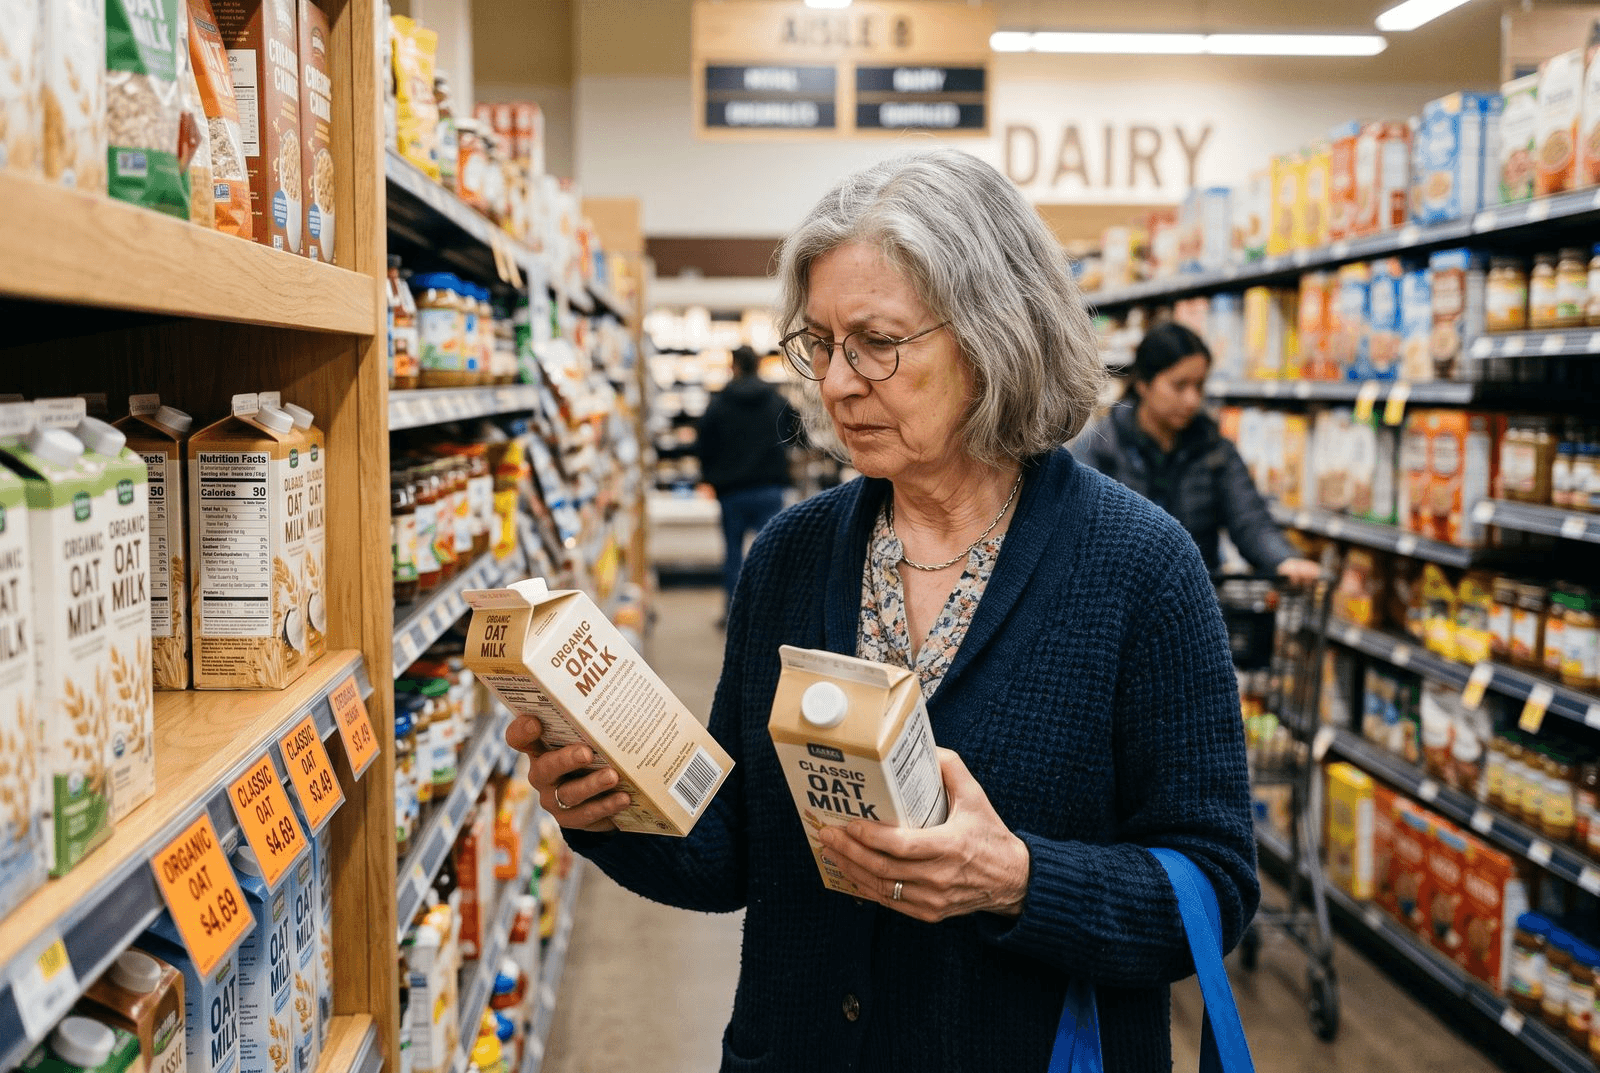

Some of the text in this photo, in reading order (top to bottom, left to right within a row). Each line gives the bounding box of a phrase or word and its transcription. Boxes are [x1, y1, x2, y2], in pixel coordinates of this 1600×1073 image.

[1004, 124, 1214, 188] DAIRY
[200, 454, 266, 464] Nutrition Facts
[150, 486, 164, 496] 50
[201, 487, 266, 497] Calories 30
[287, 492, 303, 517] OAT
[309, 483, 322, 506] OAT
[109, 515, 145, 539] ORGANIC
[285, 517, 305, 544] MILK
[64, 532, 104, 560] ORGANIC
[114, 539, 141, 574] OAT
[70, 558, 101, 598] OAT
[112, 572, 146, 612] MILK
[67, 595, 106, 640] MILK
[484, 624, 508, 641] OAT
[481, 642, 506, 658] MILK
[550, 620, 591, 668] ORGANIC
[565, 634, 598, 677] OAT
[574, 644, 618, 697] MILK
[286, 724, 315, 761] CLASSIC
[301, 749, 317, 776] OAT
[798, 760, 866, 782] CLASSIC
[237, 764, 272, 808] CLASSIC
[309, 768, 333, 803] $3.49
[807, 773, 864, 800] OAT
[255, 794, 275, 825] OAT
[806, 790, 880, 821] MILK
[265, 815, 295, 856] $4.69
[162, 826, 212, 885] ORGANIC
[188, 864, 213, 901] OAT
[200, 887, 238, 936] $4.69
[295, 879, 313, 925] OAT
[270, 915, 289, 966] OAT
[296, 911, 315, 954] MILK
[270, 949, 291, 997] MILK
[211, 973, 236, 1034] OAT
[211, 1012, 237, 1068] MILK
